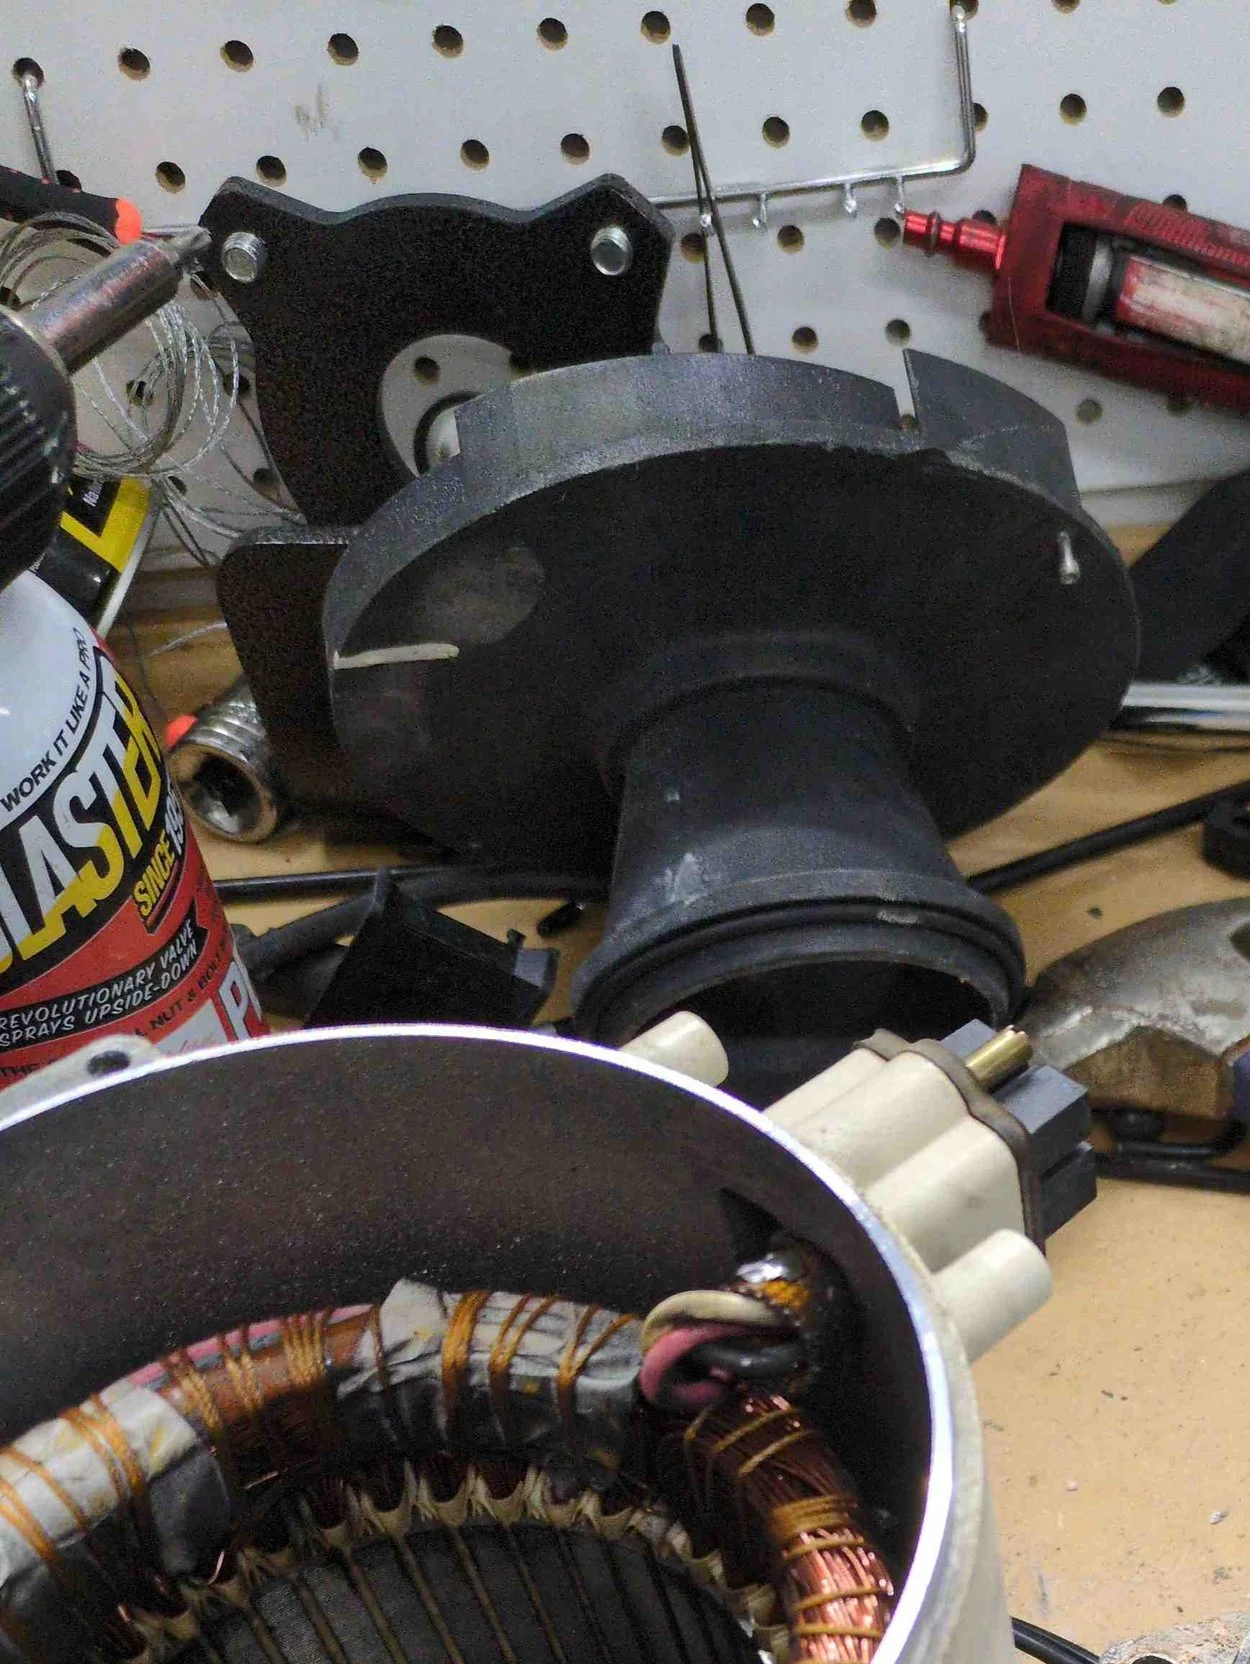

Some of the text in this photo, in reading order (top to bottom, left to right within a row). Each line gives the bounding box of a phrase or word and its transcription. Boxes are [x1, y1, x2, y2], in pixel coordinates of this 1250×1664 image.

[1, 627, 92, 812] WORK IT LIKE A PRO
[0, 656, 162, 975] LASTER
[133, 829, 175, 916] SINCE
[0, 961, 156, 1031] REVOLUTIONARY
[160, 917, 193, 969] VALVE
[0, 938, 198, 1047] SPRAYS UPSIDE-DOWN
[150, 1001, 182, 1030] NUT
